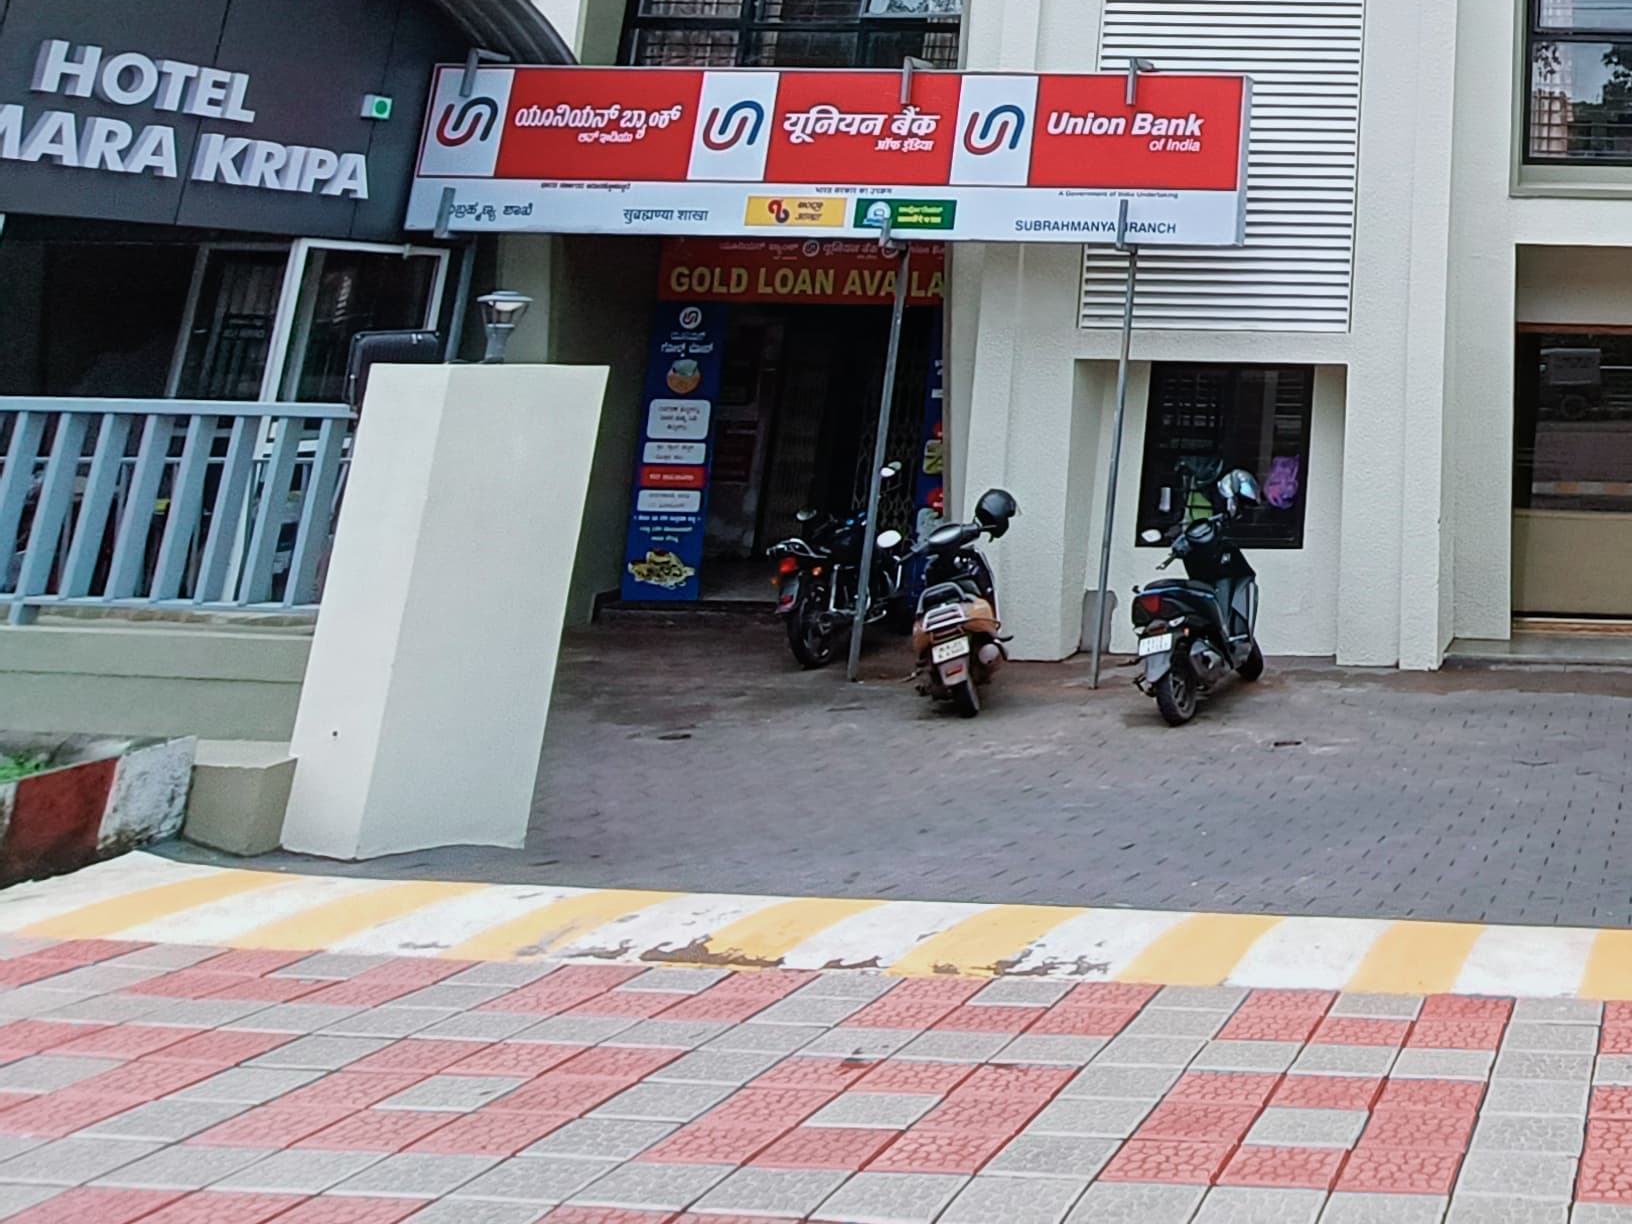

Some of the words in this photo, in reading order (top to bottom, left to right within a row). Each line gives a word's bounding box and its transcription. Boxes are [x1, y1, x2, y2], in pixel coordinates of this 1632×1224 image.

[30, 39, 256, 123] HOTEL
[514, 104, 620, 127] ಯೂನಿಯನ್
[782, 104, 887, 144] यूनियन
[890, 105, 942, 137] बैंक
[1046, 111, 1128, 136] Union
[1131, 113, 1204, 138] Bank
[1148, 138, 1164, 152] of
[1165, 138, 1201, 153] India
[191, 133, 370, 199] KRIPA
[1014, 219, 1116, 233] SUBRAHMANYA
[670, 266, 749, 294] GOLD
[757, 268, 834, 295] LOAN
[842, 270, 944, 298] AVALA
